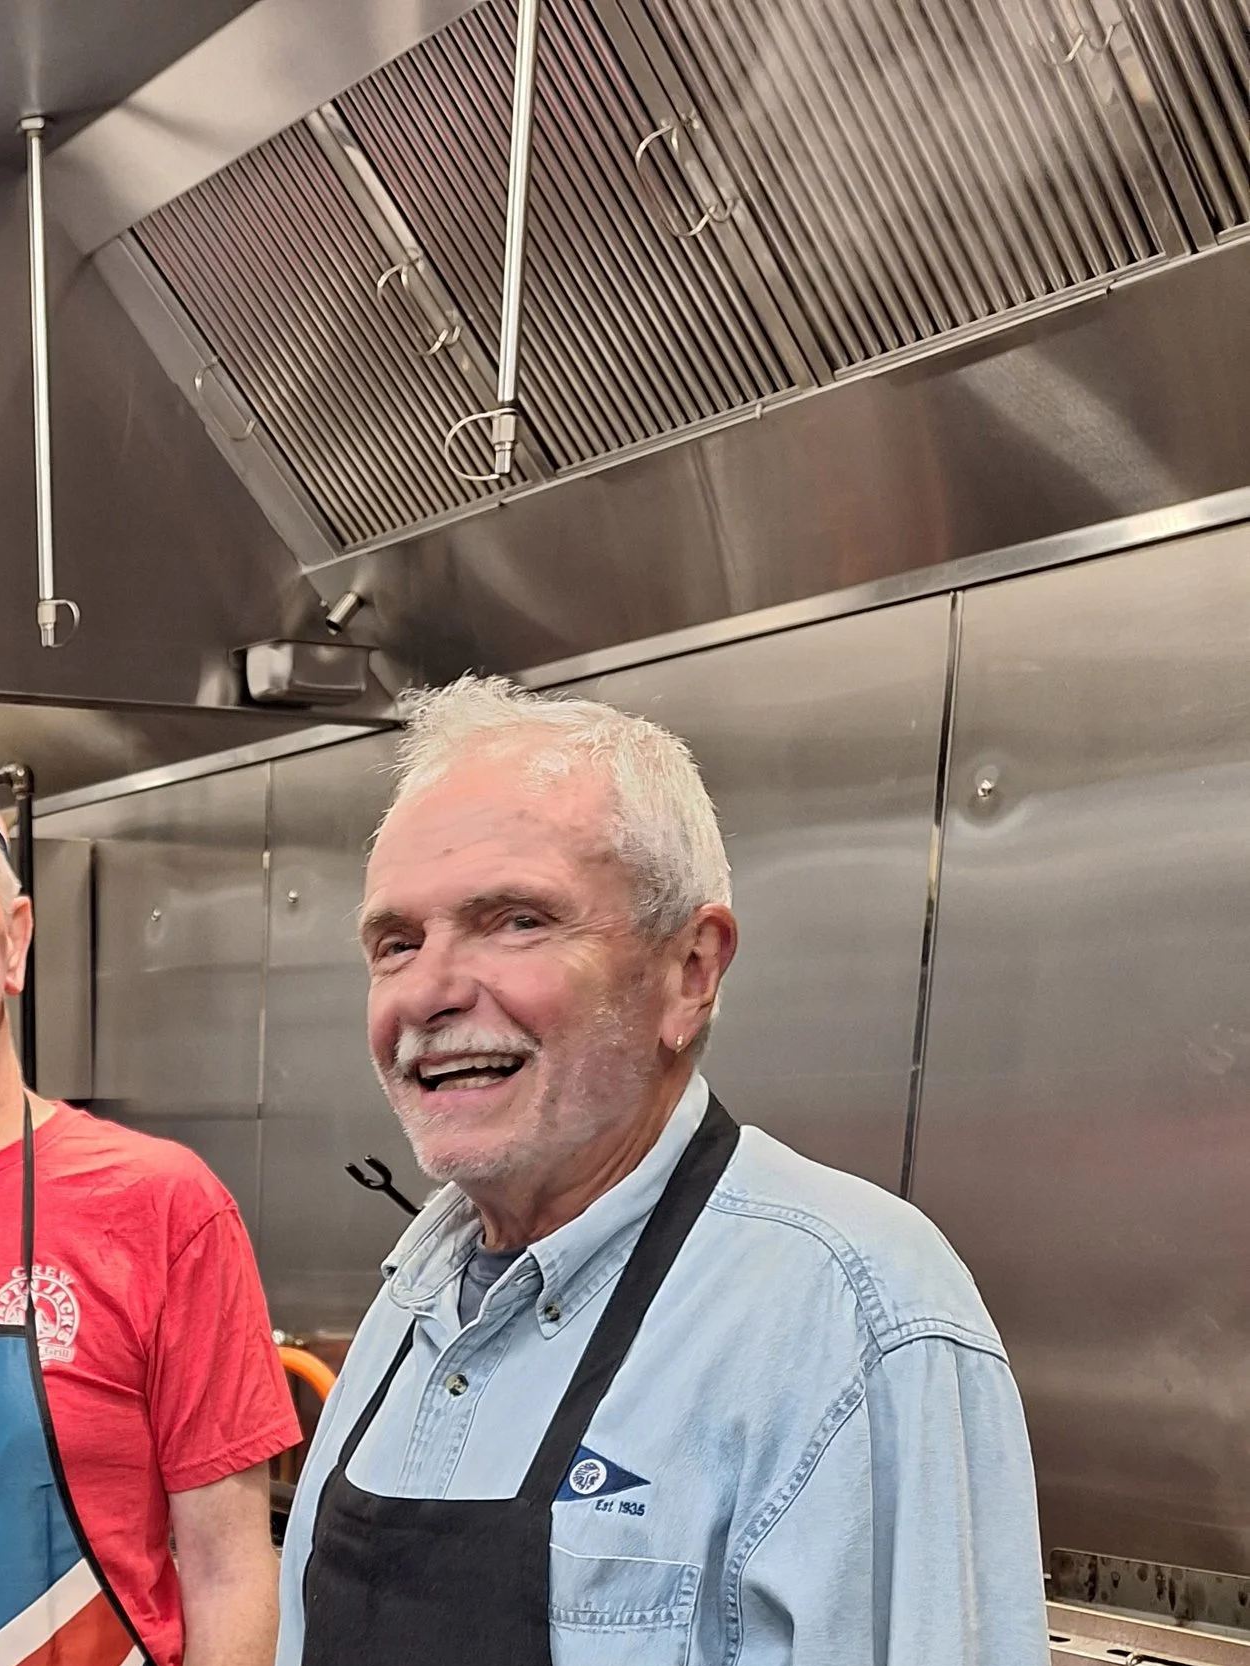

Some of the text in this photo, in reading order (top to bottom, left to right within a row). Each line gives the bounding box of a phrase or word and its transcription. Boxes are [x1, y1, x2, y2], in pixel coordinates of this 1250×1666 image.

[11, 1265, 75, 1287] CREW
[594, 1499, 646, 1517] Est 1935
